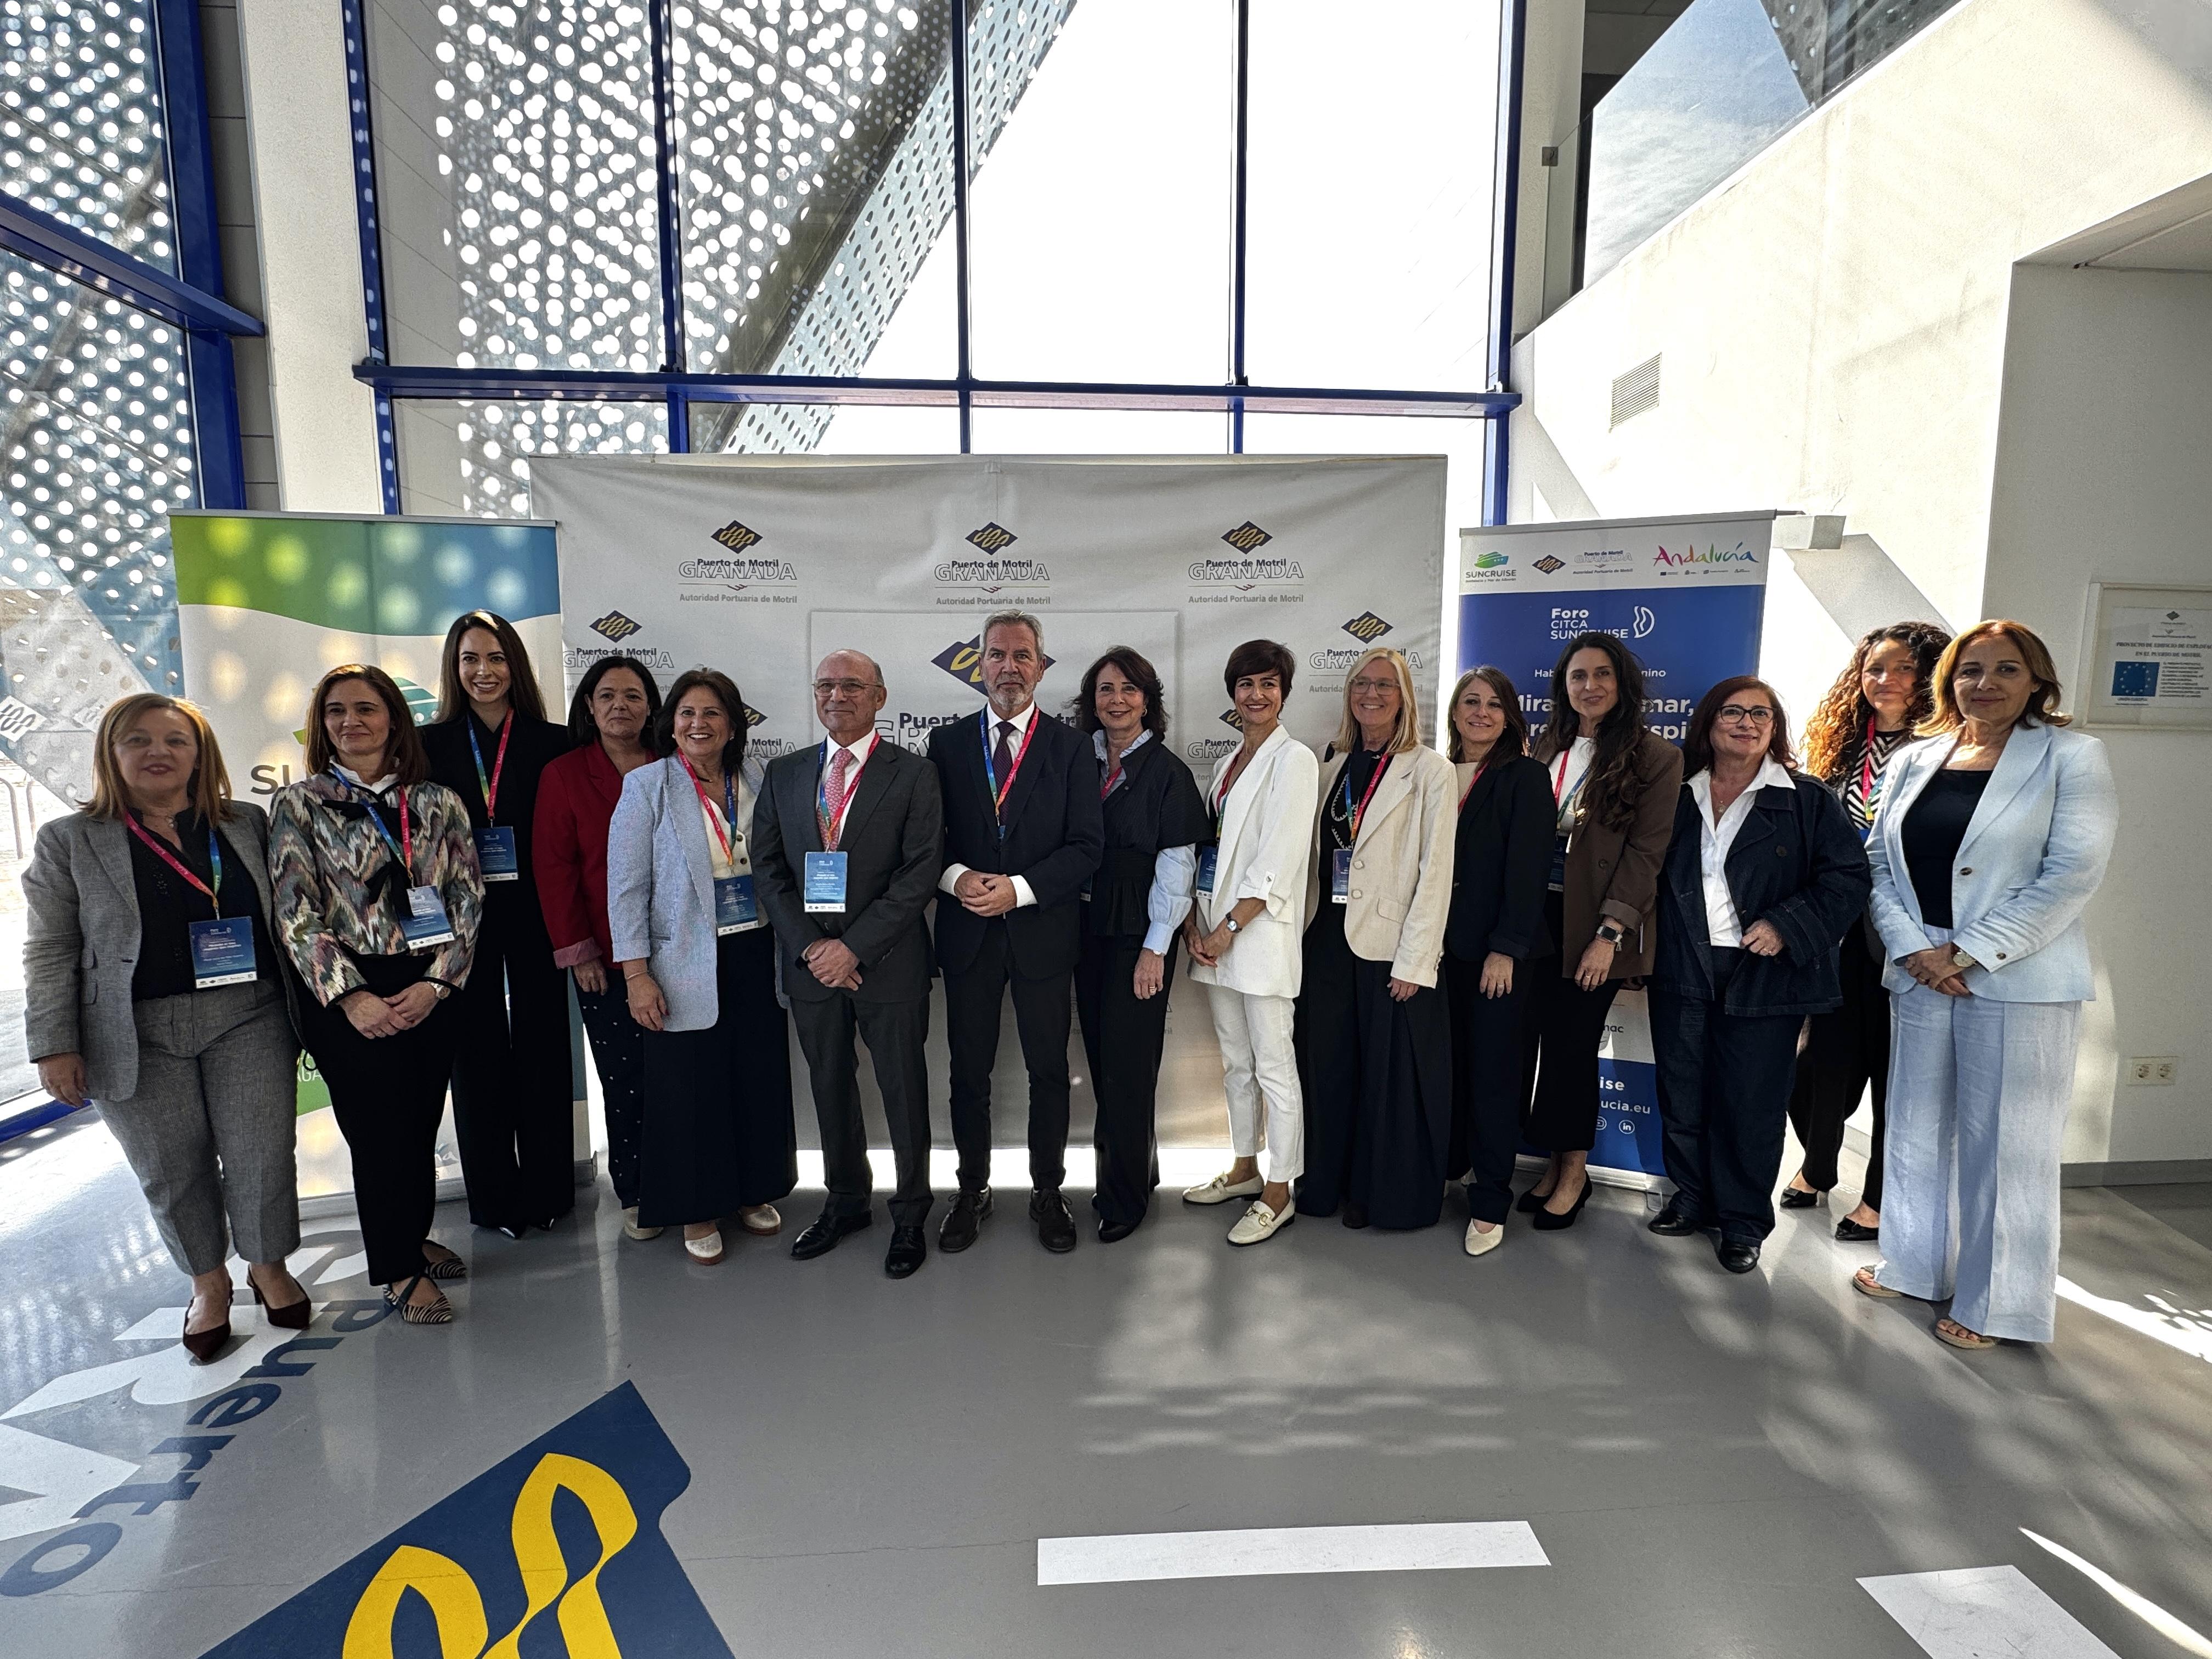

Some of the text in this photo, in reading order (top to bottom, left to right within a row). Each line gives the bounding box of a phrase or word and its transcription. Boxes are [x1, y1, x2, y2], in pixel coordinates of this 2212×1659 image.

[1653, 541, 1759, 566] Andalucía
[697, 558, 731, 567] Puerto
[749, 559, 779, 567] Motril
[987, 560, 999, 568] de
[1002, 560, 1032, 568] Motril
[679, 561, 797, 580] GRANADA
[934, 563, 1050, 581] GRANADA
[1188, 562, 1304, 580] GRANADA
[1466, 569, 1516, 578] SUNCRUISE
[721, 594, 758, 602] Portuaria
[1188, 595, 1228, 603] Autoridad
[1230, 594, 1266, 602] Portuaria
[1280, 594, 1304, 602] Motril
[1551, 608, 1589, 619] Foro
[1551, 620, 1588, 629] CITCA
[1550, 629, 1629, 640] SUNISE
[577, 647, 609, 656] Puerto
[900, 713, 960, 729] Puert
[1600, 1076, 1625, 1091] ise
[1601, 1100, 1650, 1114] ucia.eu
